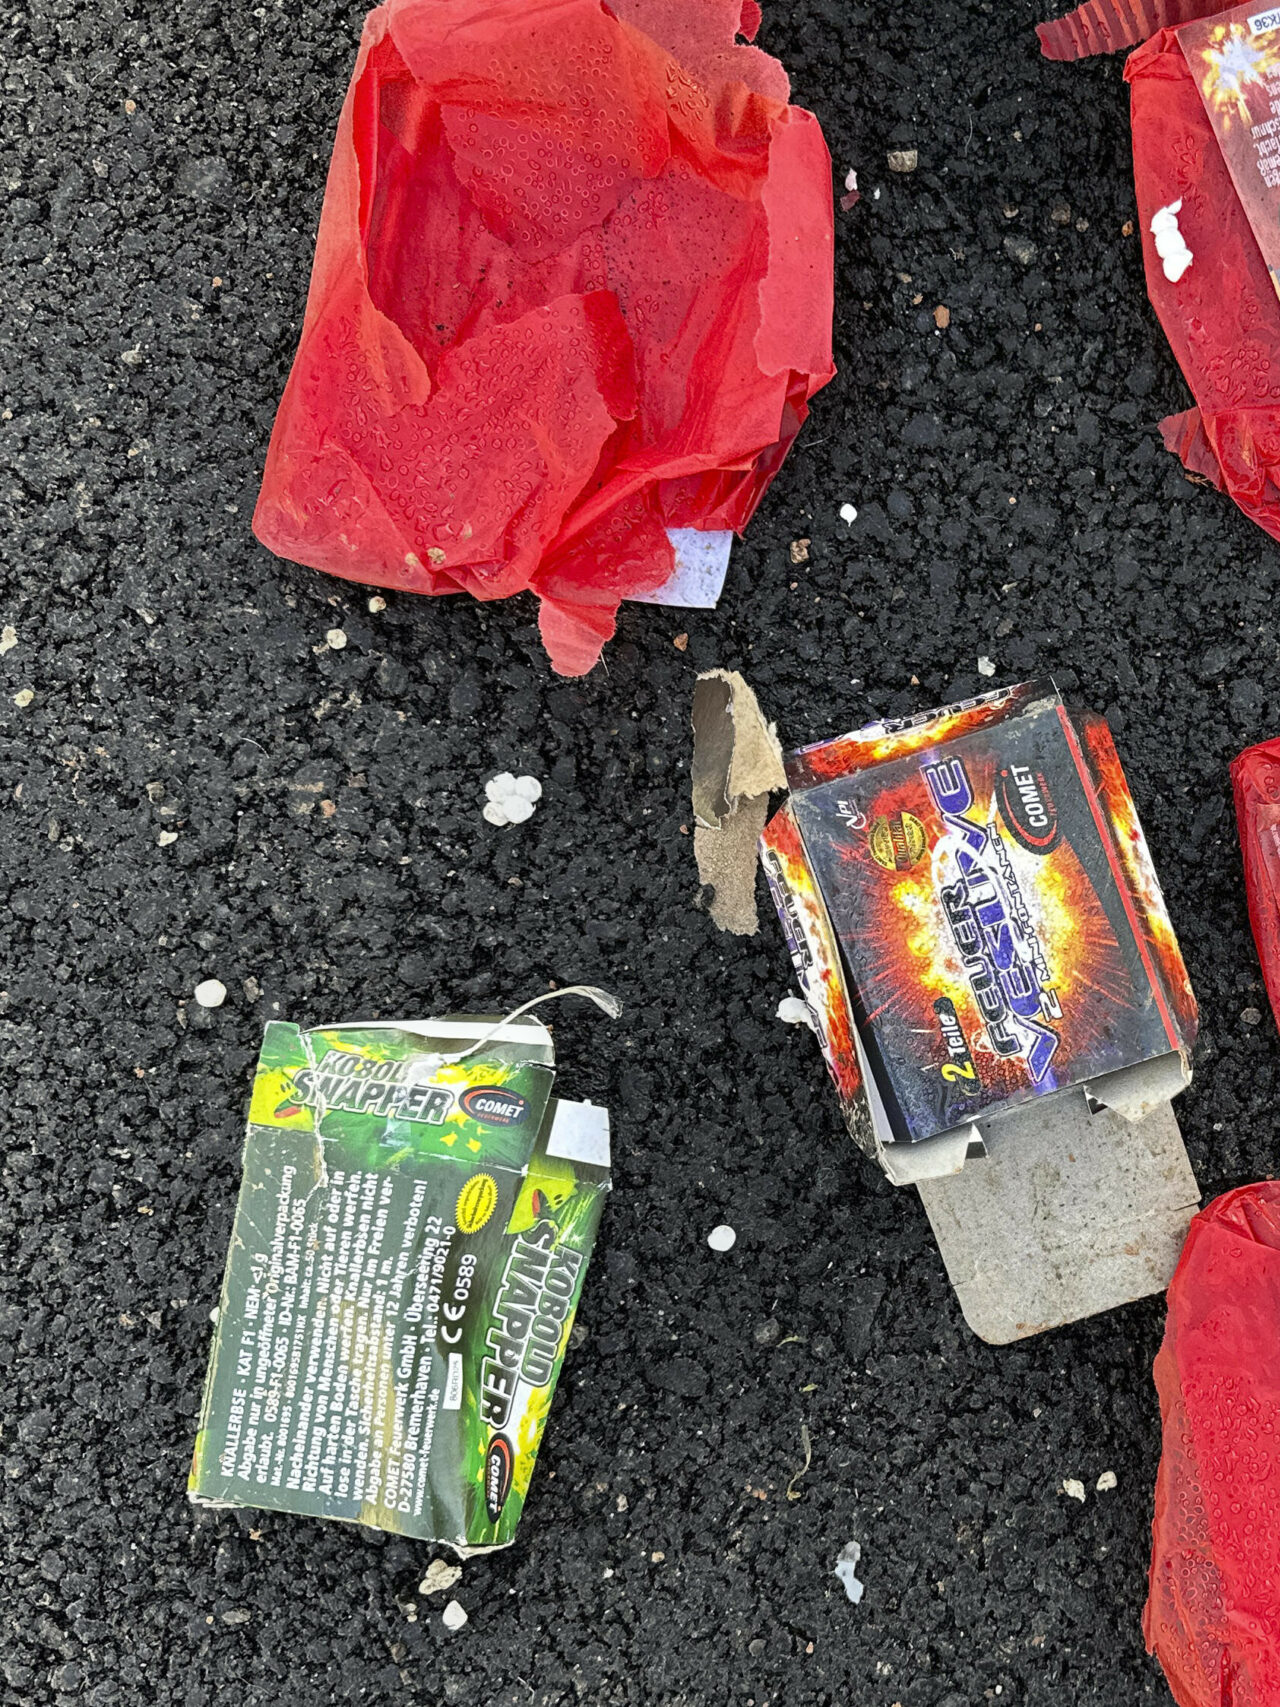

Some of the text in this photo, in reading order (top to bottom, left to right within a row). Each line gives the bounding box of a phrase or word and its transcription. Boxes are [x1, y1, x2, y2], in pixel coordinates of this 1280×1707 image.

[1010, 763, 1048, 829] COMET
[936, 1009, 975, 1086] 2 Teile
[944, 878, 1020, 1057] FEUER
[1038, 987, 1063, 1021] 2
[289, 1068, 454, 1125] SNAPPER
[474, 1097, 523, 1119] COMET
[237, 1164, 298, 1481] Abgabe nur ungeöffneter Originalverpackung
[253, 1197, 306, 1483] erlaubt. 0589-F1-0065 BAM-F1-0065
[285, 1169, 345, 1489] Nacheinander verwenden. Nicht auf oder in
[302, 1168, 362, 1492] Richtung von Menschen oder Tieren werfen.
[317, 1171, 379, 1495] Auf harten Boden werfen. Knallerbsen nicht
[334, 1175, 394, 1497] lose in der Tasche tragen. Nur im Freien ver-
[381, 1215, 442, 1509] COMET Feuerwerk GmbH 22
[397, 1225, 456, 1513] D-27580 Bremerhaven Tel.: 0471/9021-0
[453, 1252, 477, 1301] 0589
[480, 1218, 559, 1430] SNAPPER
[519, 1242, 584, 1387] KOBOLD
[221, 1329, 255, 1477] KNALLERBSE KAT F1
[348, 1255, 393, 1501] wenden. Sicherheitsabstand: 1 m.
[364, 1250, 409, 1505] Abgabe an Personen unter 12 Jahren
[411, 1387, 439, 1516] www.comet-feuerwerk.de
[486, 1453, 501, 1514] COMET
